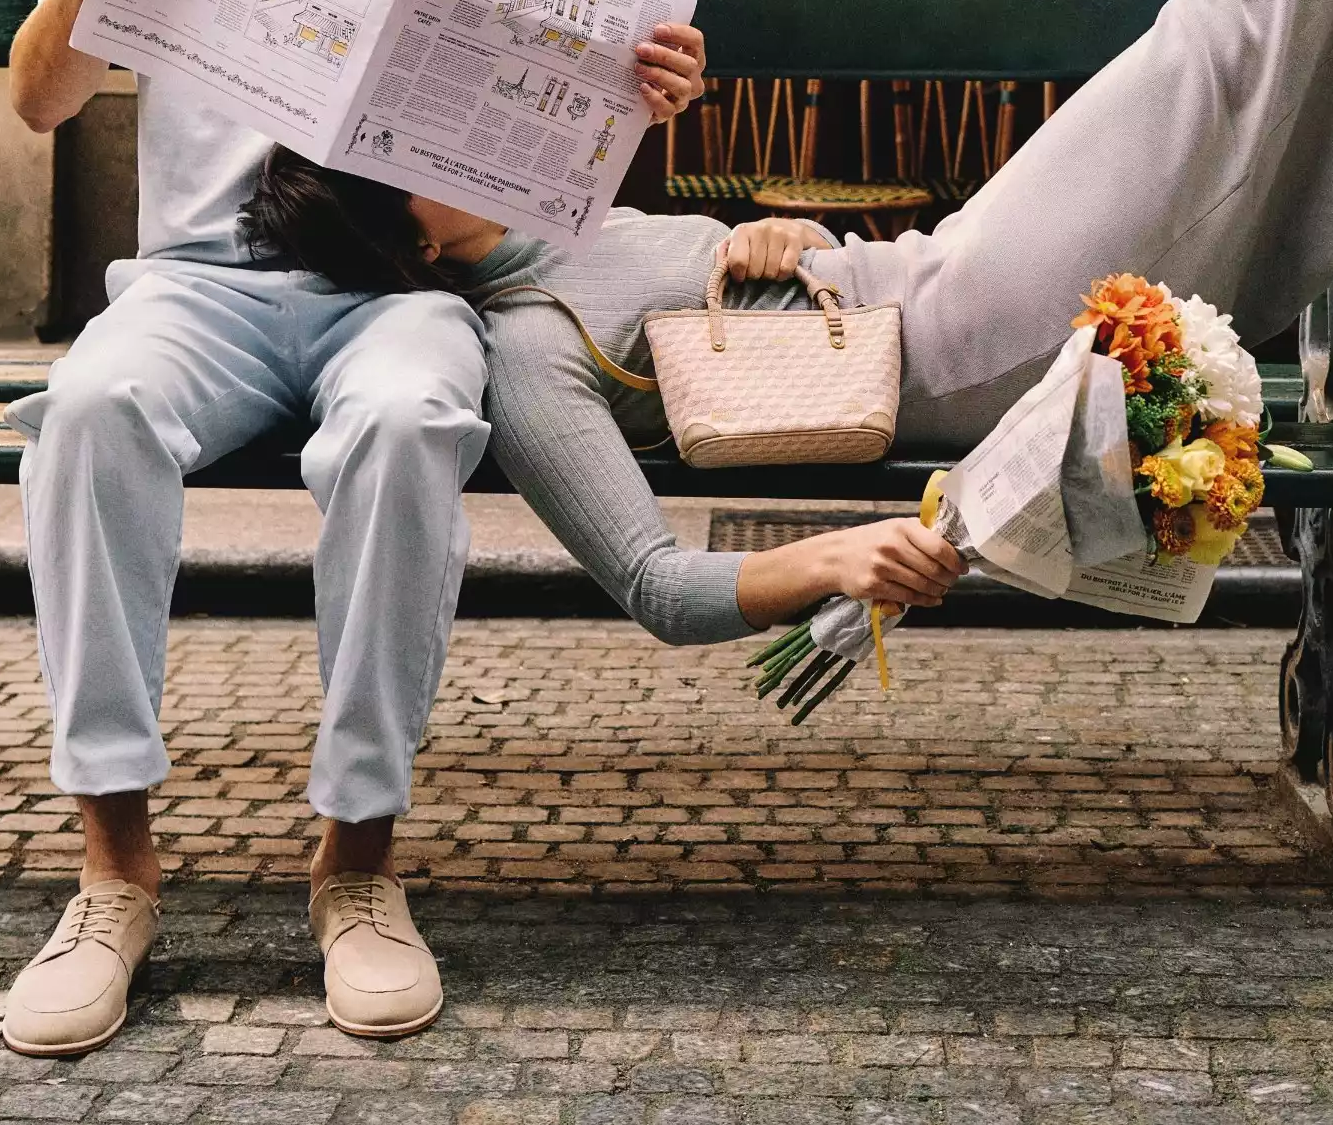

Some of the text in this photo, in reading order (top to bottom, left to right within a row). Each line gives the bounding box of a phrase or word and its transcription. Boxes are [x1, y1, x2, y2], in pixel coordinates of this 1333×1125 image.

[409, 145, 420, 153] DU
[419, 148, 444, 162] BISTROT
[449, 159, 479, 176] L'ATELIER,
[497, 177, 531, 195] PARISIENNE
[431, 161, 447, 171] TABLE
[466, 174, 484, 185] FAURÉ
[490, 183, 505, 193] PAGE
